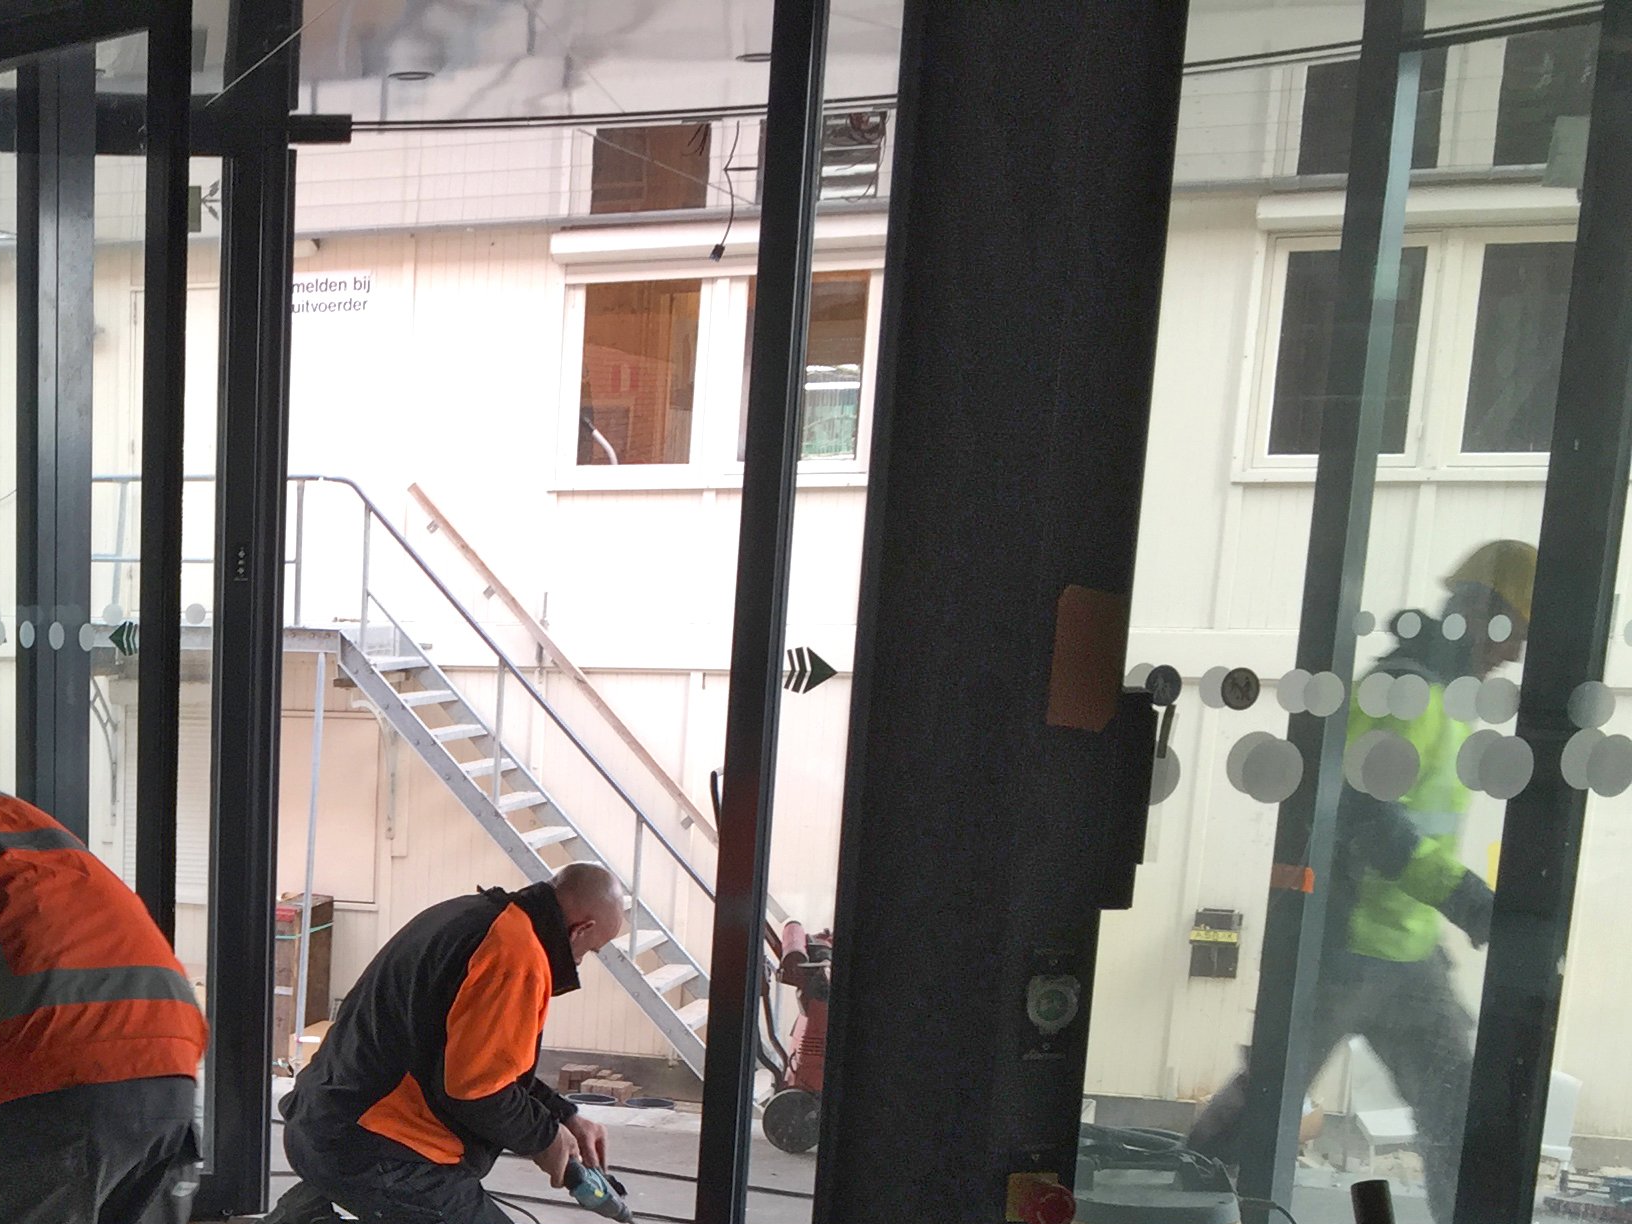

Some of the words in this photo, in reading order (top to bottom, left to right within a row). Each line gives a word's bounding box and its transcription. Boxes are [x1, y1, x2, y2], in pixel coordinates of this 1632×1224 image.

[292, 278, 348, 293] melden
[353, 276, 371, 293] bij
[291, 298, 368, 313] uitvoerder
